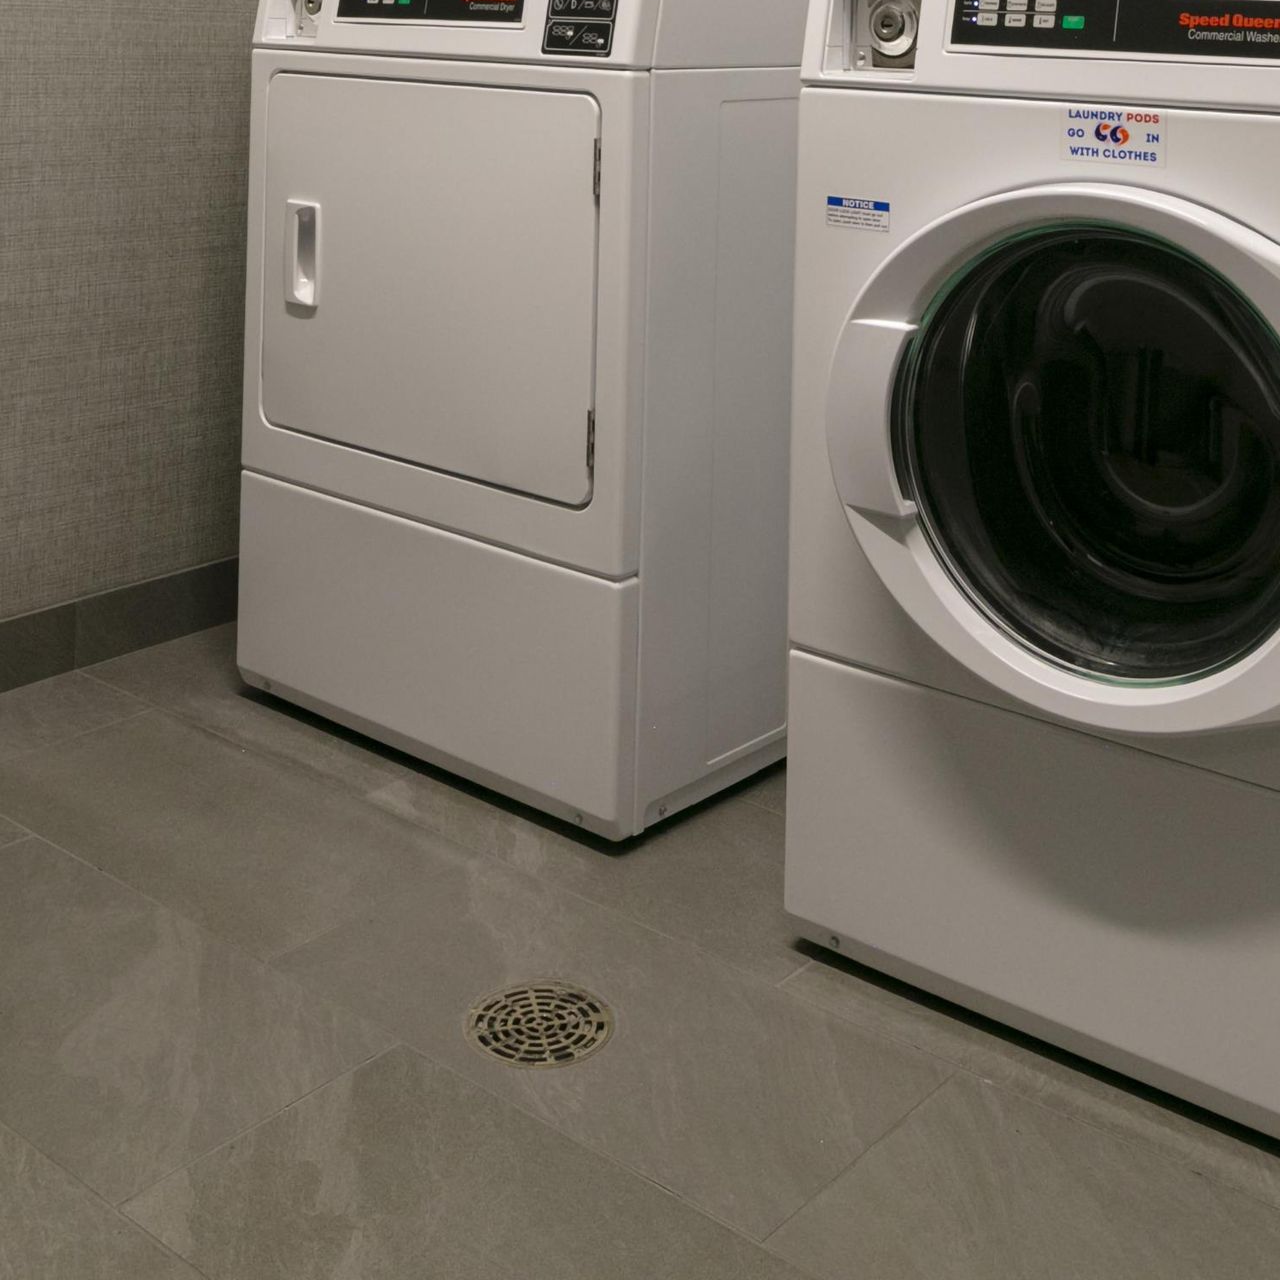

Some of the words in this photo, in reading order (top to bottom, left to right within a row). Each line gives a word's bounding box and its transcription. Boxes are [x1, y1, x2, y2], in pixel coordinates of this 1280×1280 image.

[469, 2, 499, 11] Commercial
[500, 3, 515, 12] Dryer
[1179, 12, 1230, 28] Speed
[1188, 29, 1244, 41] Commercial
[1068, 109, 1122, 121] LAUNDRY
[1127, 113, 1159, 123] PODS
[1067, 128, 1084, 137] GO
[1146, 133, 1159, 143] IN
[1070, 146, 1099, 157] WITH
[1103, 149, 1157, 161] CLOTHES
[842, 199, 874, 209] NOTICE
